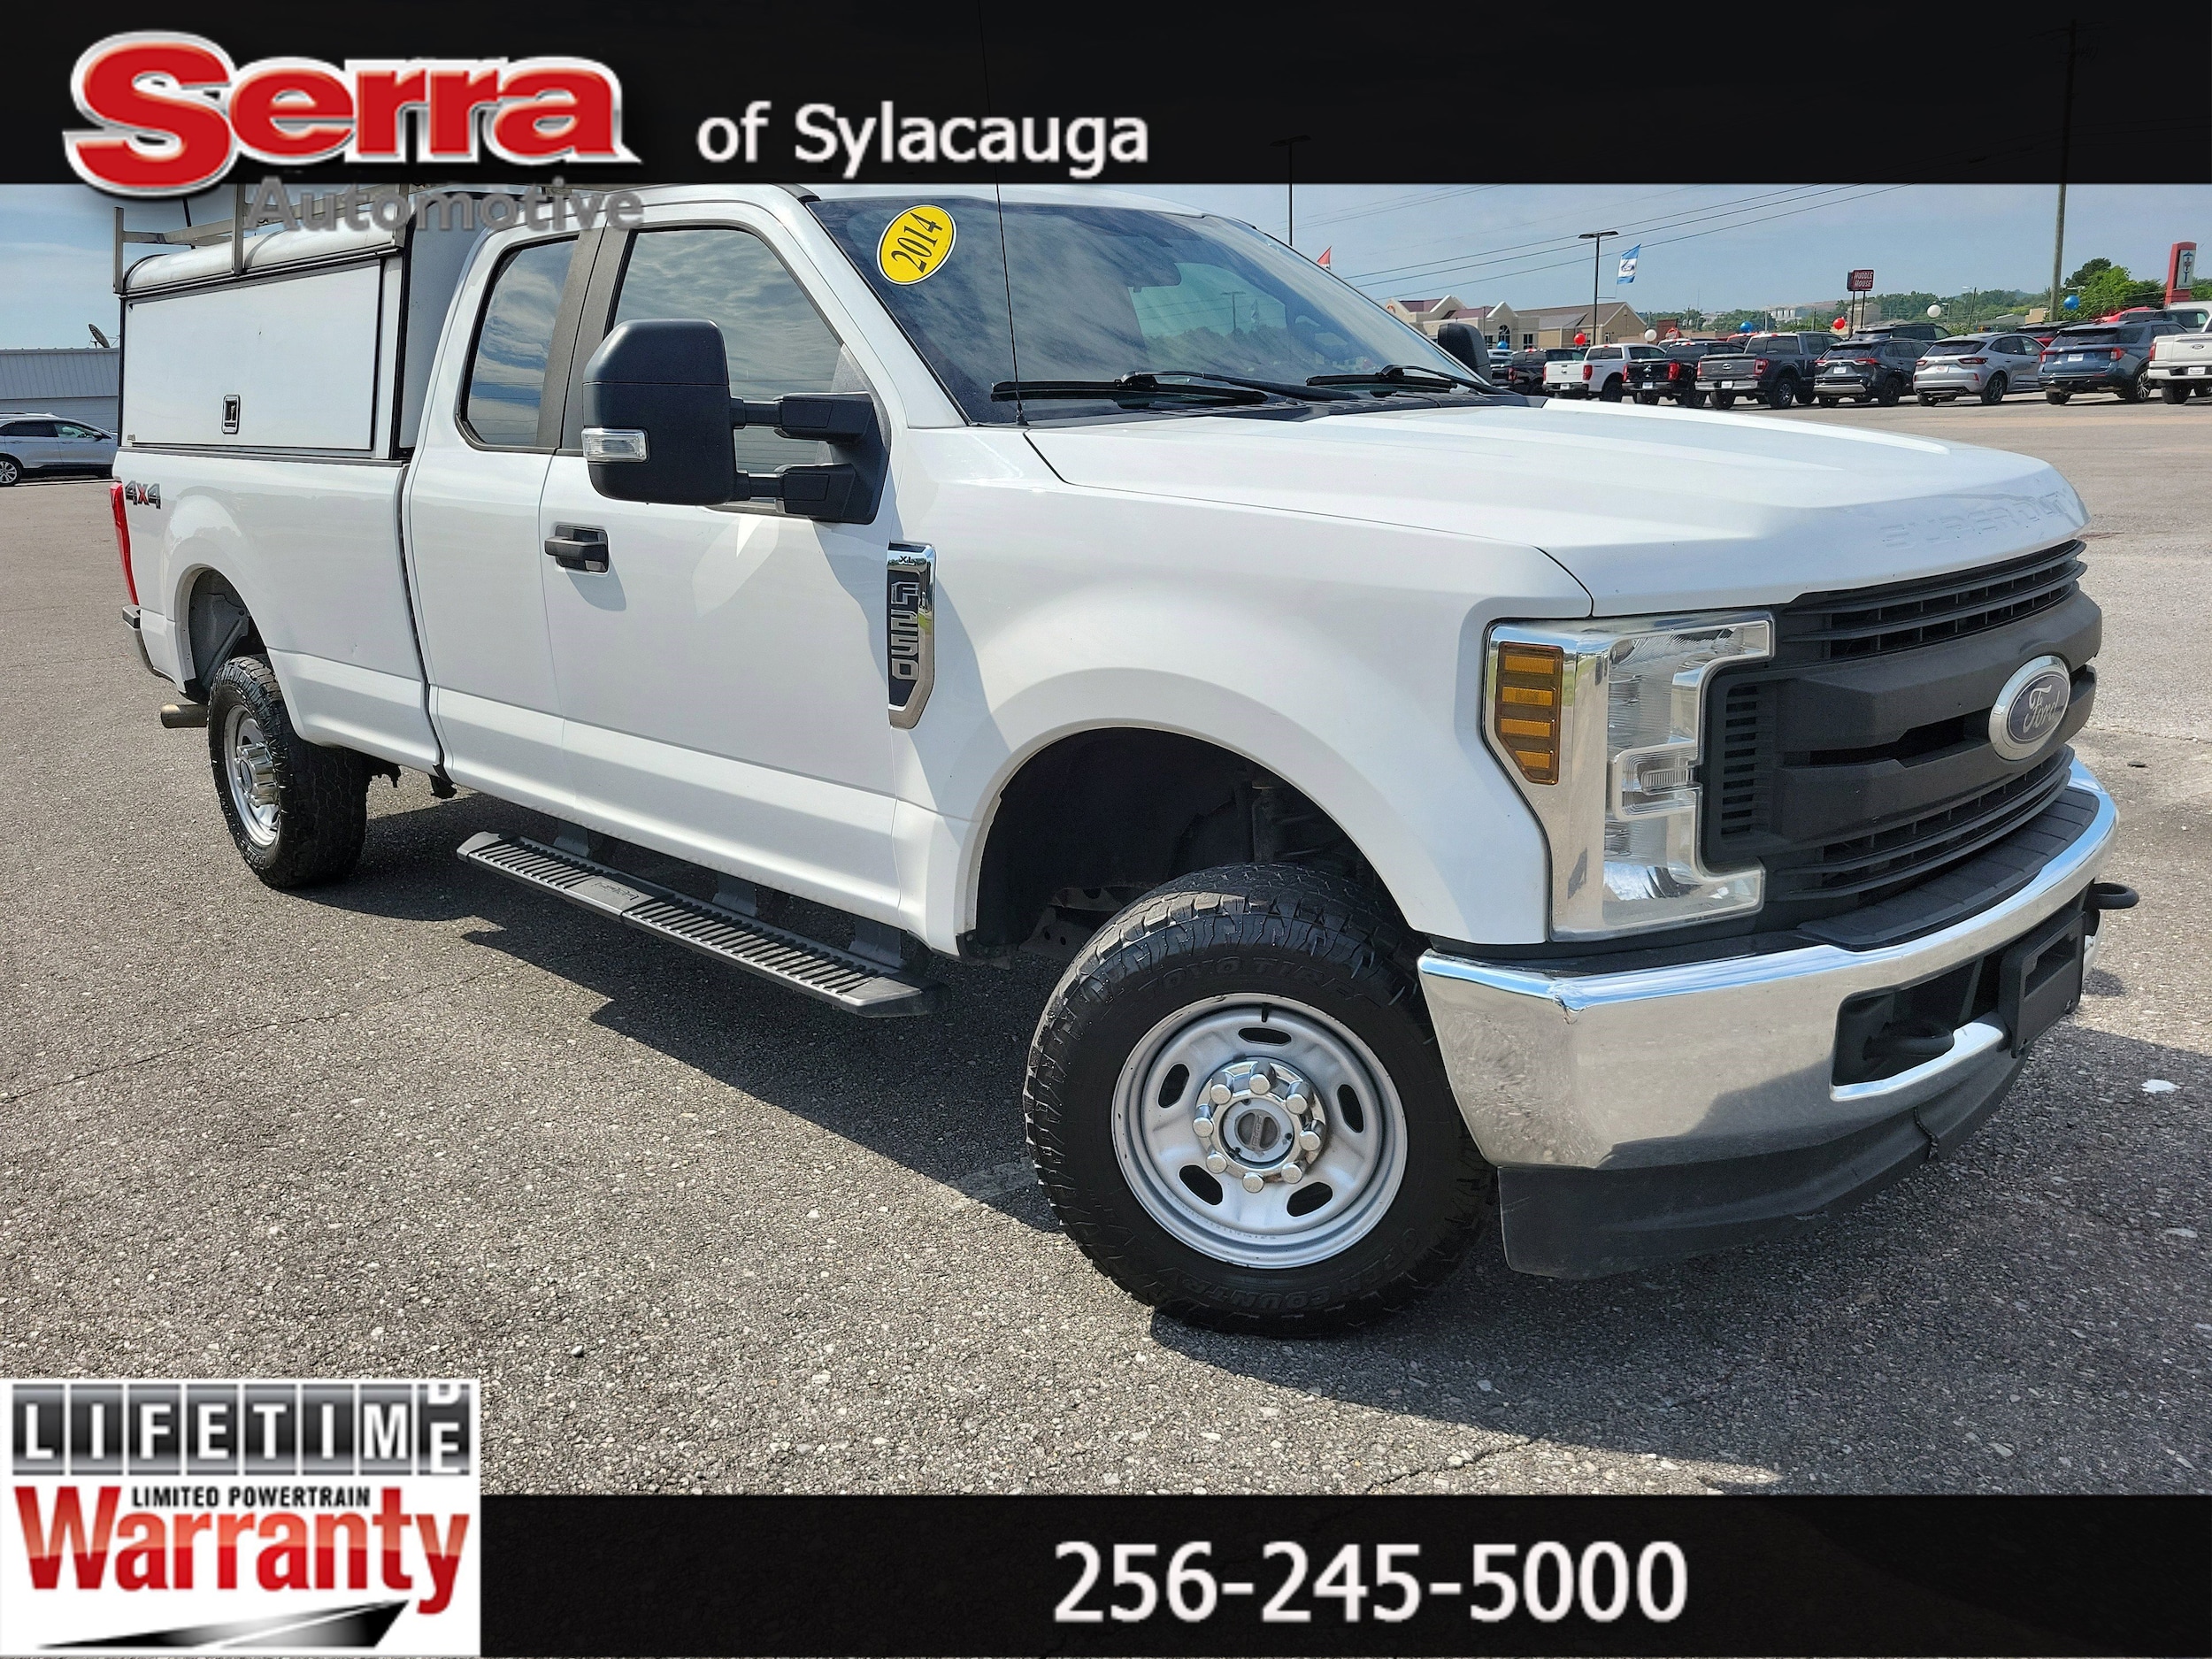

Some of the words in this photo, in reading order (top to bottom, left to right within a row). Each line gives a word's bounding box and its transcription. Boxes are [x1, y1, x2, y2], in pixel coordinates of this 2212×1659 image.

[890, 211, 943, 273] 2014
[899, 555, 915, 565] XL
[2023, 684, 2061, 733] Ford
